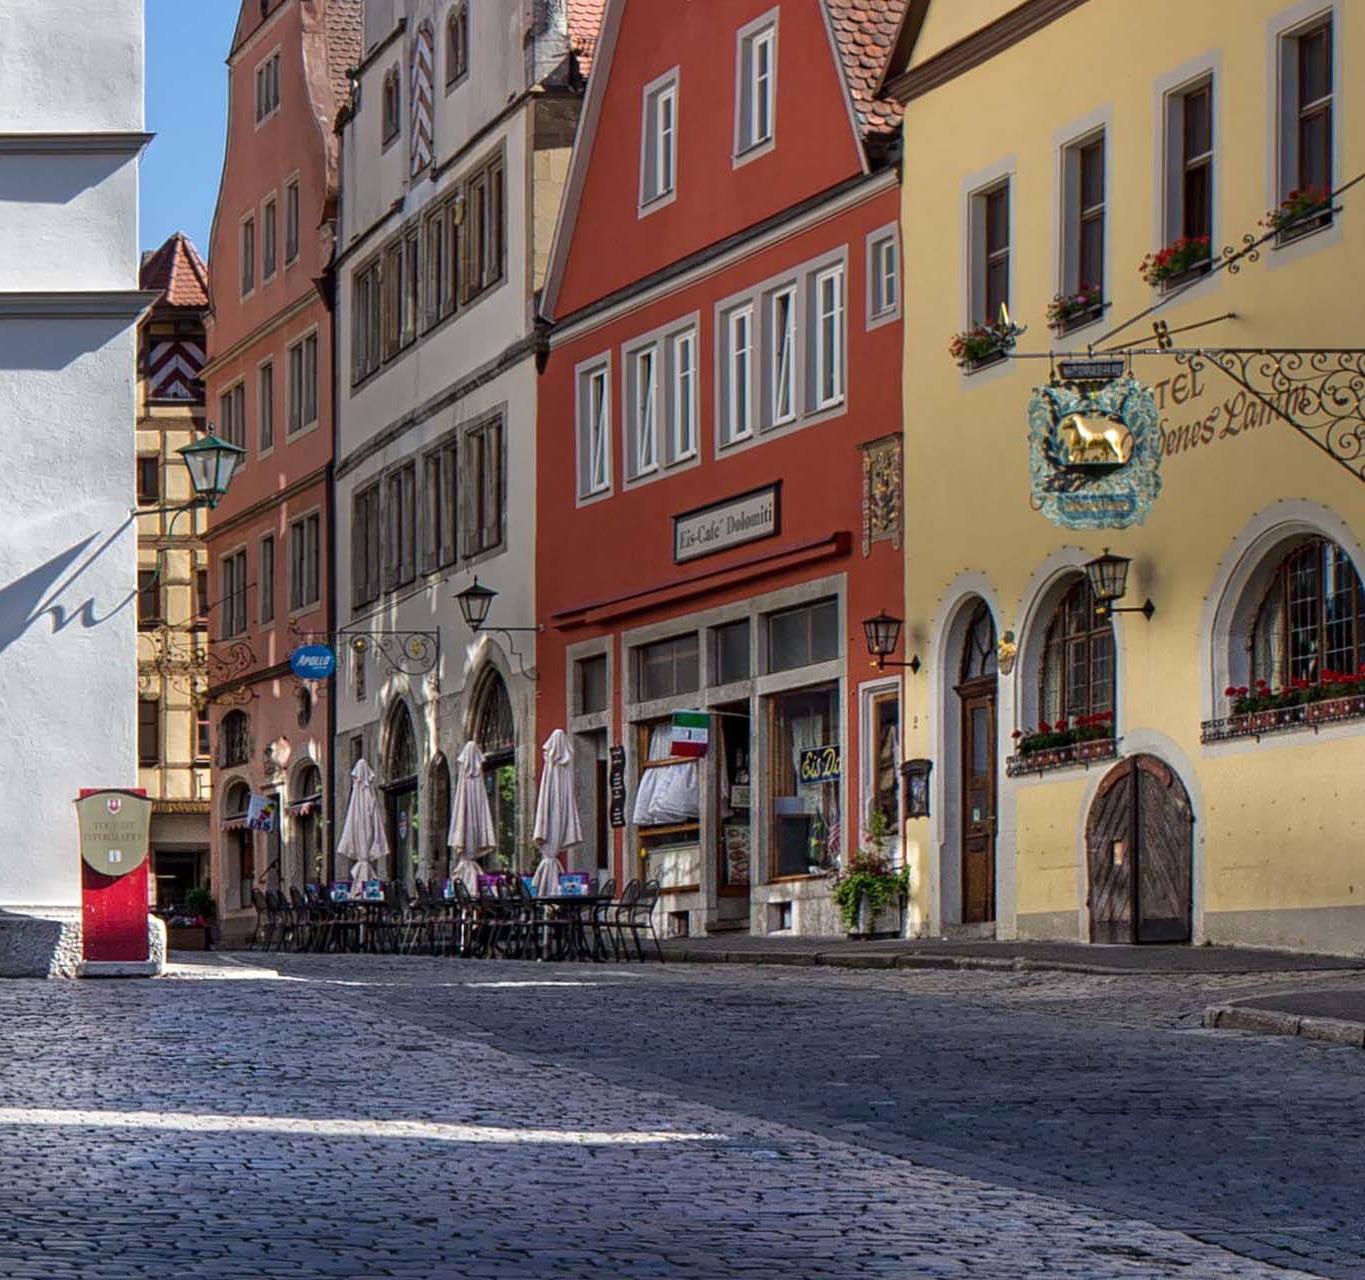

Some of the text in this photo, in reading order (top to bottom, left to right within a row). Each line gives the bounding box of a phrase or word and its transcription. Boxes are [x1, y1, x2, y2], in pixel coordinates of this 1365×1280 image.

[1155, 368, 1205, 410] TEL
[726, 501, 773, 535] Dolomiti
[802, 751, 821, 779] Eis
